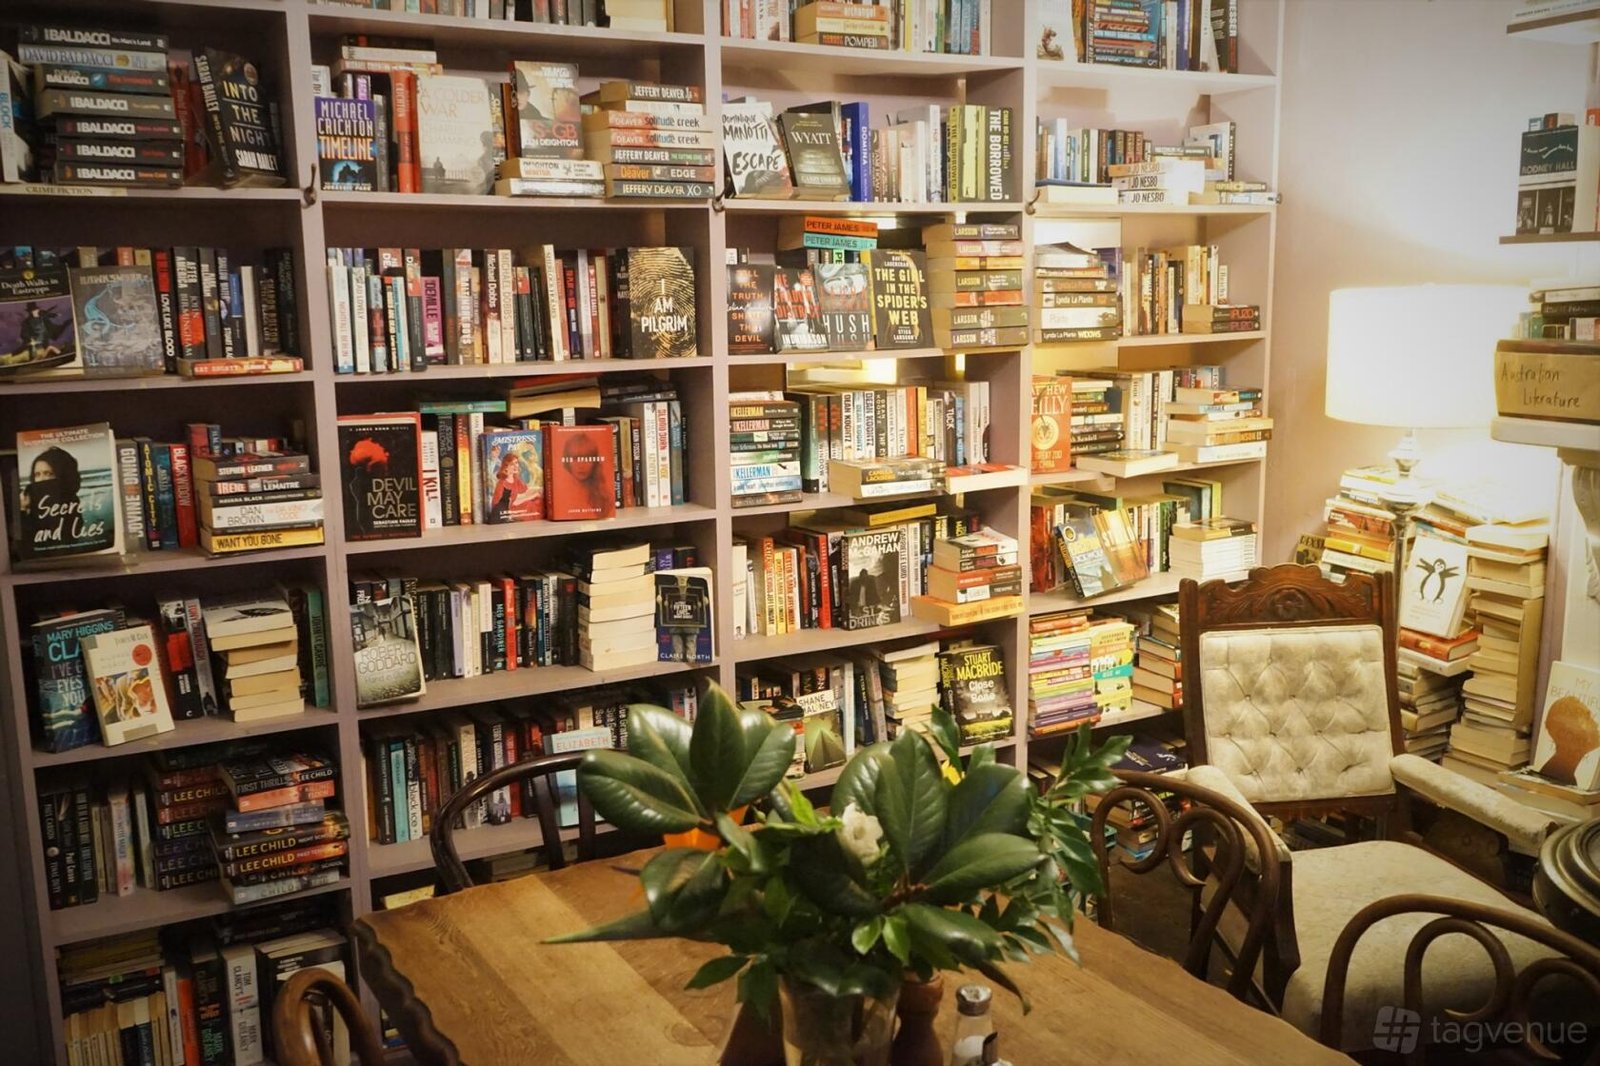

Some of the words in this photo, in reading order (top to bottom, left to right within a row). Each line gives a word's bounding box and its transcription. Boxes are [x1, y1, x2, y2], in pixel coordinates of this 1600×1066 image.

[223, 79, 258, 101] INTO
[634, 85, 660, 98] JEFFERY
[661, 87, 685, 99] DEAVER
[232, 104, 261, 123] THE
[321, 101, 369, 120] MICHAEL
[318, 118, 373, 137] CRICHTON
[677, 117, 700, 128] creek
[990, 110, 1001, 133] THE
[677, 135, 700, 145] creek
[723, 123, 769, 141] MANOTTI
[790, 130, 832, 145] WYATT
[319, 136, 374, 160] TIMELINE
[614, 149, 643, 161] JEFFERY
[644, 150, 670, 161] DEAVER
[621, 167, 649, 178] Deaver
[670, 168, 696, 178] EDGE
[732, 151, 780, 175] ESCAPE
[990, 135, 1002, 200] BORROWED
[622, 183, 652, 194] JEFFERY
[654, 184, 684, 195] DEAVER
[686, 184, 701, 195] XO
[806, 220, 831, 231] PETER
[833, 222, 859, 233] JAMES
[805, 236, 830, 247] PETER
[832, 237, 857, 248] JAMES
[176, 256, 188, 288] AMERICA
[187, 262, 198, 283] AFTER
[487, 254, 495, 279] Michael
[875, 269, 895, 281] THE
[886, 284, 896, 293] IN
[900, 284, 915, 294] THE
[958, 277, 981, 286] LARSSON
[425, 281, 439, 320] DEMILLE
[488, 280, 498, 308] Dobbs
[877, 295, 927, 309] SPIDER'S
[654, 298, 673, 313] AM
[179, 293, 193, 357] BIRMINGHAM
[641, 316, 688, 333] PILGRIM
[823, 314, 871, 334] HUSH
[889, 311, 919, 326] WEB
[954, 315, 977, 325] LARSSON
[165, 330, 175, 356] BLOOD
[953, 335, 976, 344] LARSSON
[1502, 361, 1560, 384] Australian
[844, 394, 852, 413] DEAN
[865, 392, 874, 413] DEAN
[1523, 388, 1580, 408] Literature
[945, 407, 955, 430] TUCK
[844, 414, 852, 443] KOONTZ
[865, 414, 874, 447] KOONTZ
[173, 447, 186, 475] BLACK
[176, 476, 190, 507] WIDOW
[372, 477, 417, 492] DEVIL
[367, 491, 403, 506] MAY
[372, 504, 417, 519] CARE
[34, 524, 60, 543] and
[217, 536, 240, 549] WANT
[242, 534, 259, 547] YOU
[851, 532, 899, 548] ANDREW
[47, 630, 74, 642] MARY
[76, 620, 114, 637] HIGGINS
[358, 652, 416, 675] GODDARD
[965, 652, 991, 665] STUART
[957, 661, 1004, 681] MACBRIDE
[58, 675, 84, 694] EYES
[969, 679, 994, 691] Close
[63, 689, 86, 707] YOU
[799, 694, 825, 706] SHANE
[408, 783, 419, 809] black
[410, 812, 419, 828] ice
[236, 845, 259, 858] LEE
[260, 837, 297, 853] CHILD
[240, 861, 260, 873] LEE
[262, 853, 295, 868] CHILD
